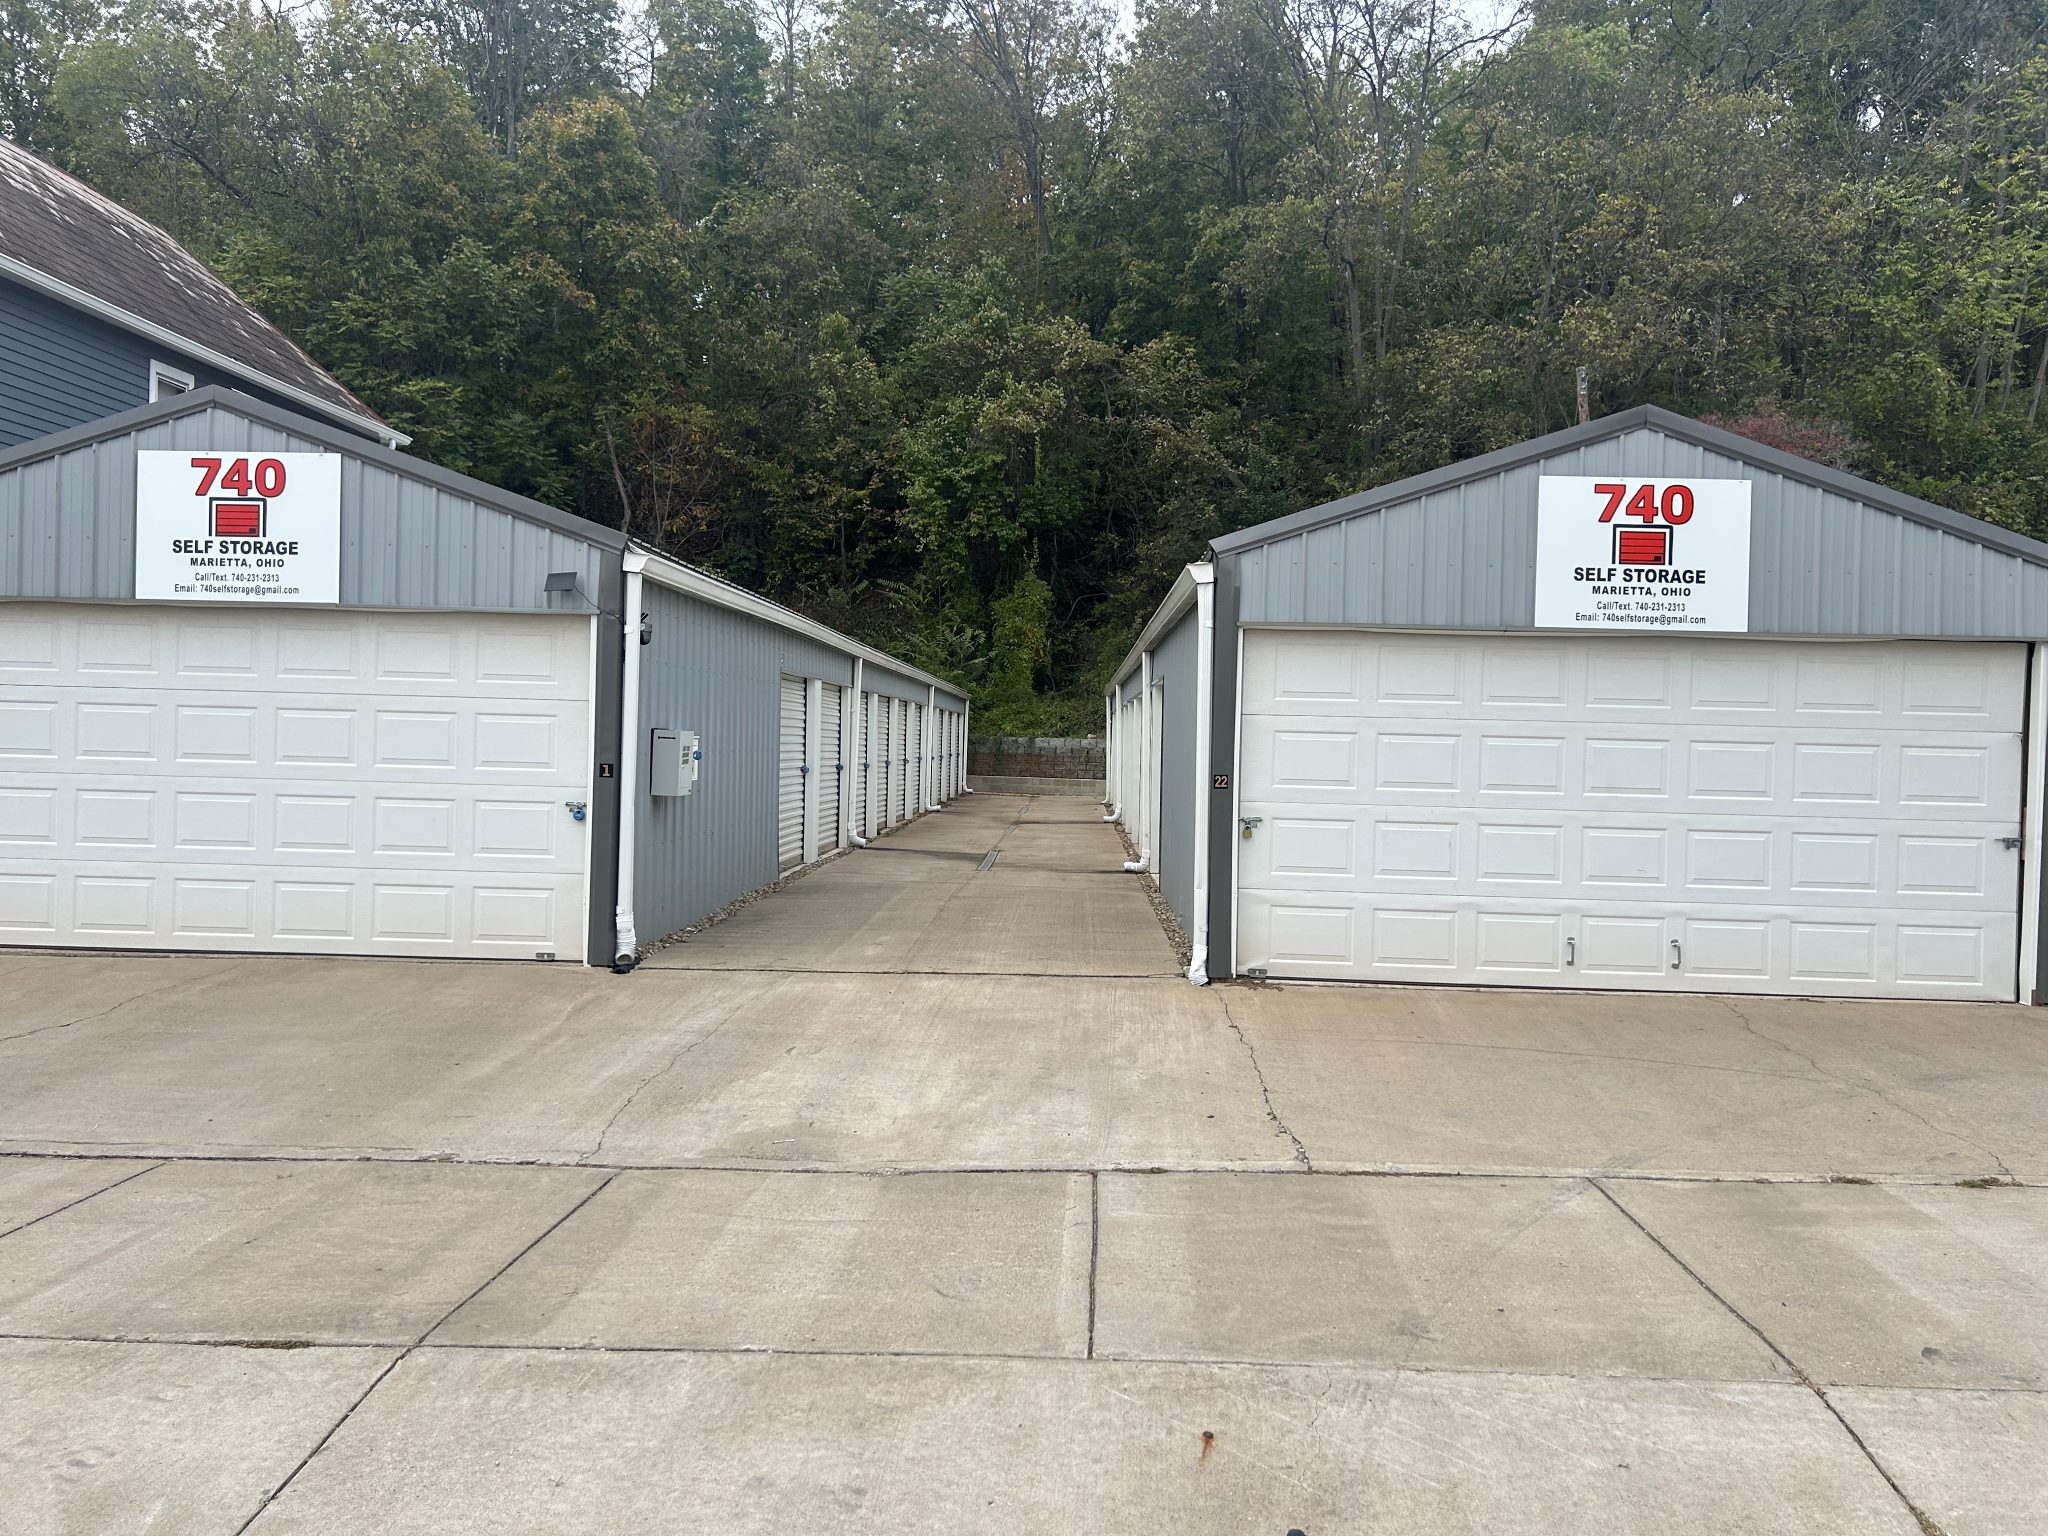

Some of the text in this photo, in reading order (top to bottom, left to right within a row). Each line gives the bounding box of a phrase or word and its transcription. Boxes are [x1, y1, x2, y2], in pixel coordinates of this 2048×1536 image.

[191, 458, 286, 497] 740
[1594, 484, 1694, 525] 740
[172, 539, 299, 555] SELF STORAGE
[190, 558, 285, 568] MARIETTA, OHIO
[232, 574, 280, 582] 740-231-2313
[1574, 567, 1706, 584] SELF STORAGE
[174, 584, 299, 595] Email: 740selfstorage@gmail.com
[1592, 586, 1691, 597] MARIETTA, OHIO
[1635, 603, 1686, 612] 740-231-2313
[1575, 613, 1706, 624] Email: 740selfstorage@gmail.com
[602, 764, 611, 777] 1
[1214, 775, 1228, 788] 22
